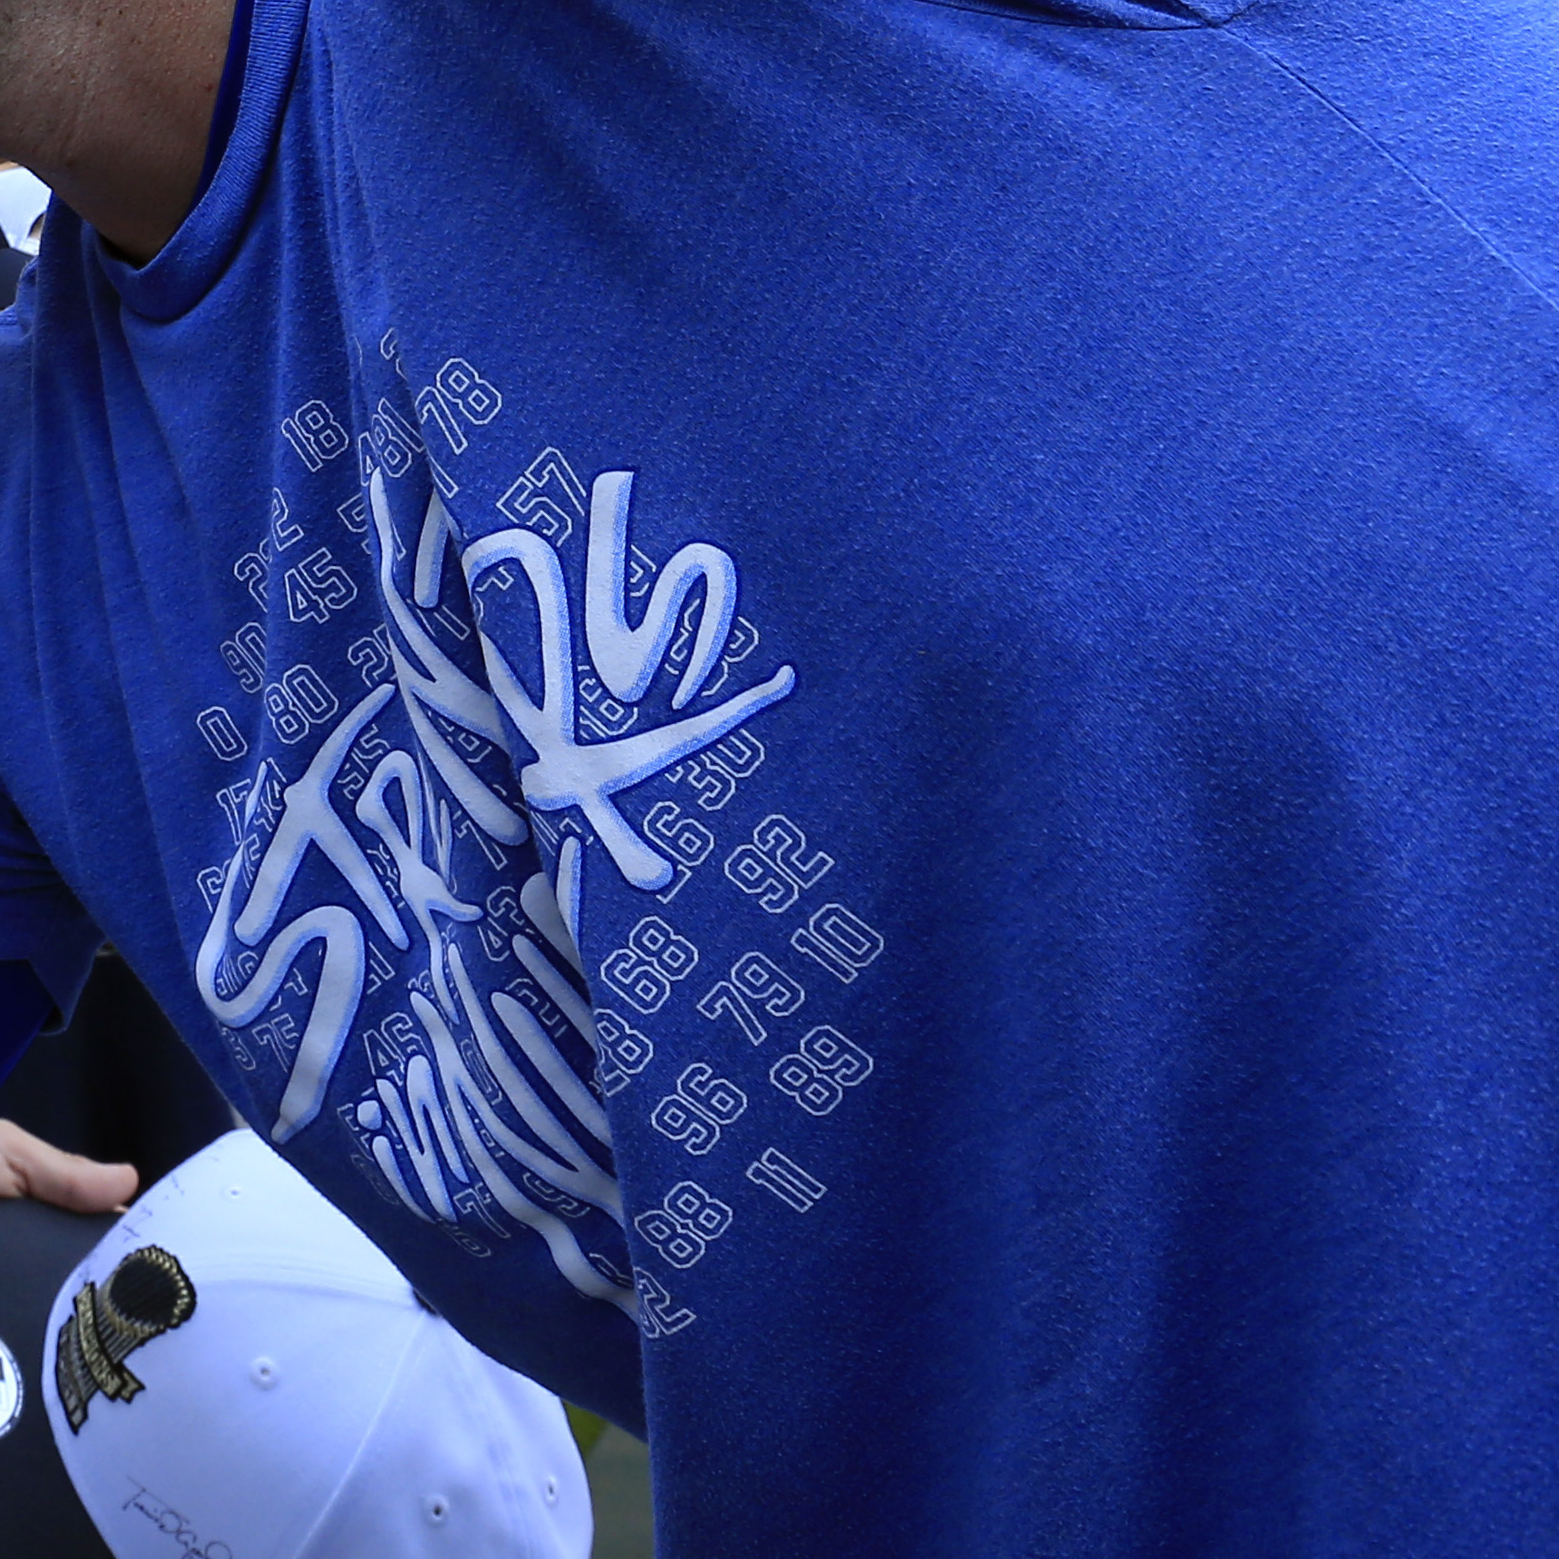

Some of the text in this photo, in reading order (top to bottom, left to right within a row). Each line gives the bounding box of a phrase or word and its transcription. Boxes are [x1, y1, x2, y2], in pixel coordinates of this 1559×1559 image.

[281, 399, 350, 473] 18
[414, 356, 503, 455] 78
[495, 445, 587, 548] 57
[283, 546, 359, 625] 45
[219, 621, 267, 694] 90
[195, 705, 249, 763] 0
[263, 663, 340, 746] 80
[723, 817, 836, 914] 92
[599, 915, 700, 1015] 68
[789, 903, 884, 984] 10
[696, 950, 806, 1046] 79
[650, 1061, 748, 1156] 96
[768, 1024, 875, 1116] 89
[745, 1145, 828, 1214] 11
[633, 1180, 733, 1269] 88
